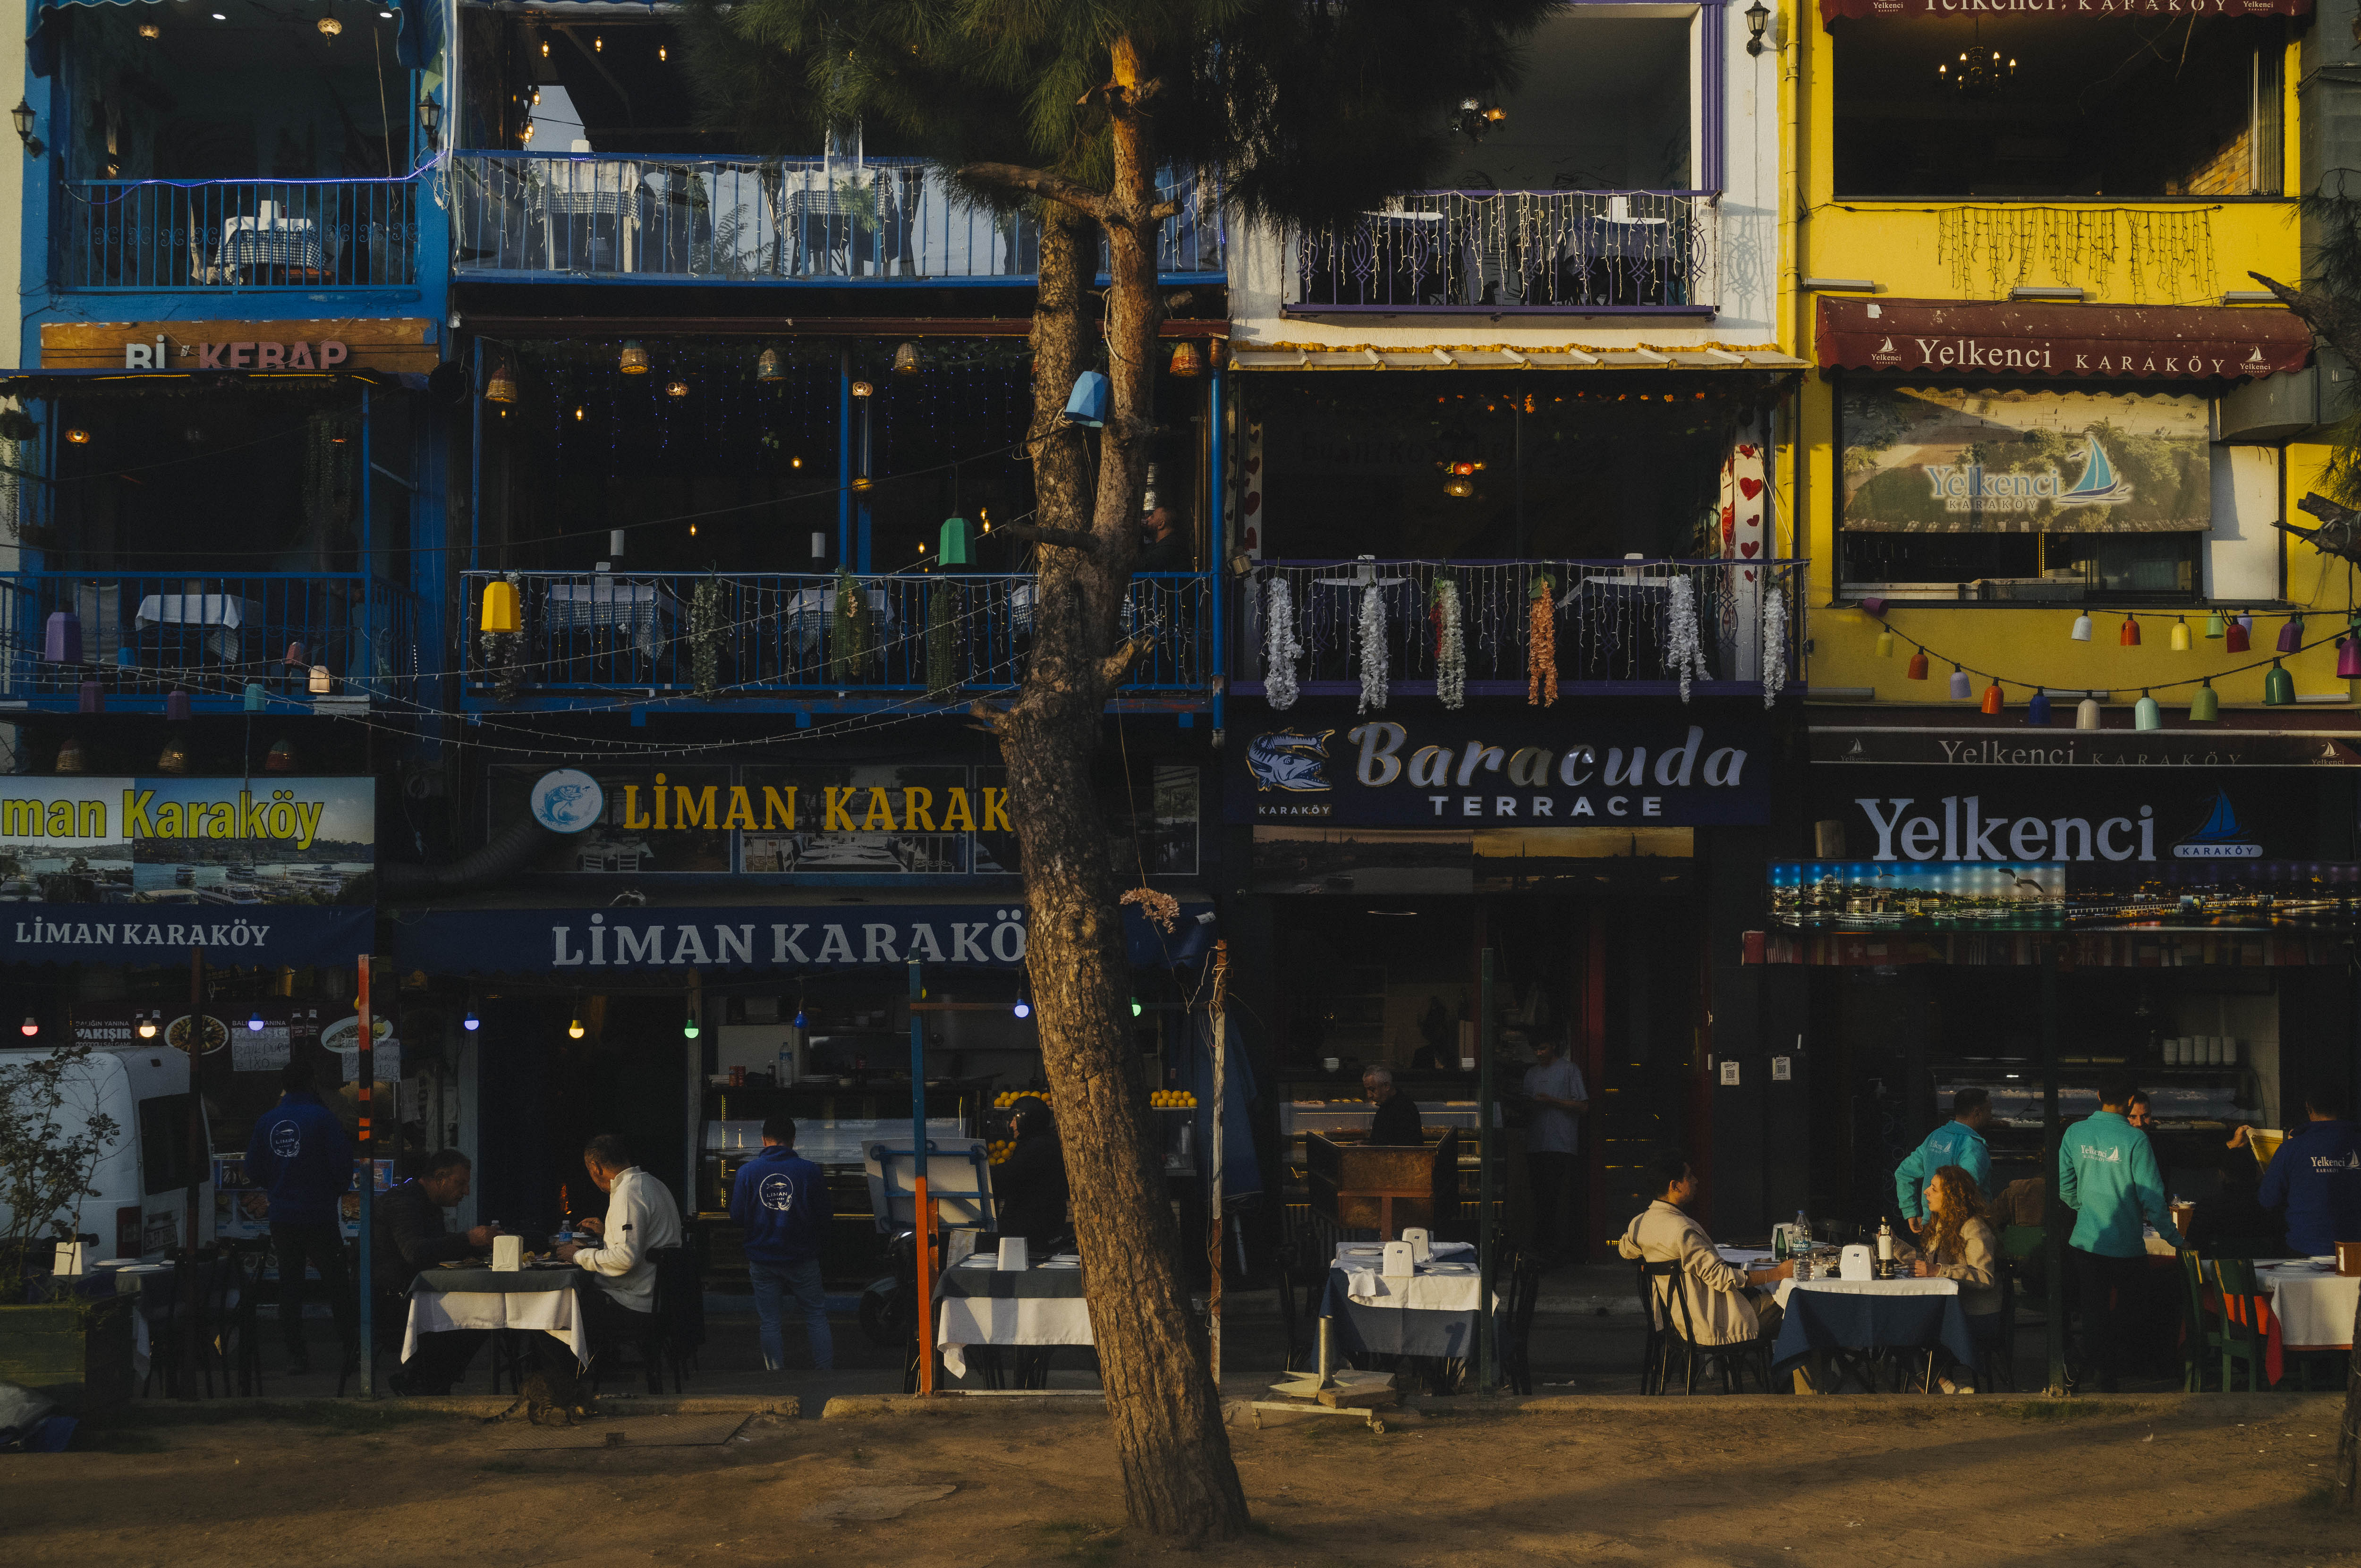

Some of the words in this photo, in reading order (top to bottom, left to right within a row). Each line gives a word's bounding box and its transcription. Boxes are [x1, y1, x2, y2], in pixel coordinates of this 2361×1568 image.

[1915, 339, 2052, 368] Yelkenci
[2075, 354, 2225, 373] KARAKÖY
[1927, 466, 2058, 496] Yelkenci
[1949, 499, 2036, 509] KARAKÖY
[1348, 720, 1748, 789] Baracuda
[1938, 740, 2075, 764] Yelkenci
[2092, 751, 2242, 765] KARAKÖY
[623, 772, 798, 831] LİMAN
[1258, 805, 1330, 814] KARAKÖY
[1428, 796, 1663, 817] TERRACE
[2, 798, 107, 838] man
[123, 789, 324, 850] Karaköy
[1855, 795, 2157, 862] Yelkenci
[2183, 846, 2253, 855] KARAKÖY
[16, 916, 116, 944] LİMAN
[123, 918, 271, 947] KARAKÖY
[552, 913, 756, 966] LİMAN
[75, 1028, 132, 1042] YAKIŞIR
[2081, 1144, 2107, 1158] Yelkenci
[2310, 1155, 2345, 1167] Yelkenci
